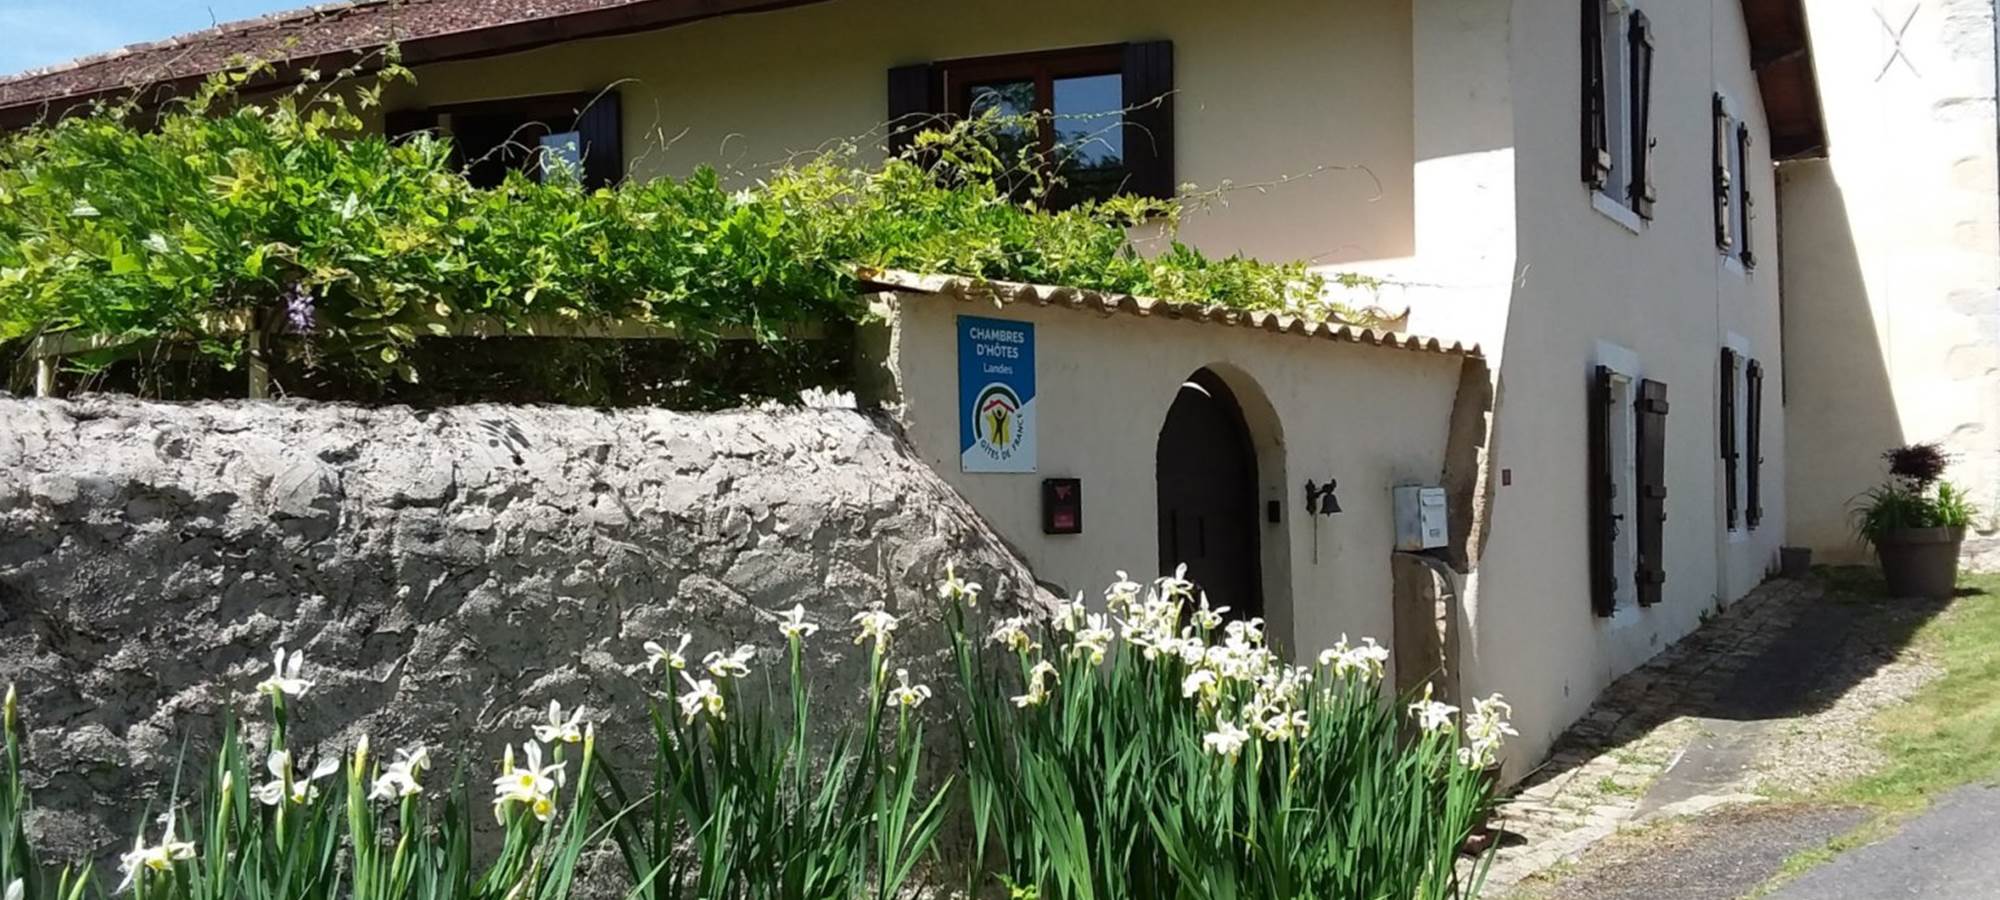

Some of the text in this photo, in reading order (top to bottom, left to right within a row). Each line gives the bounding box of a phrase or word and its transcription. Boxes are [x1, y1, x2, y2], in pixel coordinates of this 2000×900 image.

[969, 327, 1025, 343] CHAMBRES
[976, 342, 1019, 359] D'HÔTES
[983, 362, 1014, 375] Landes
[1001, 448, 1012, 460] DE
[1011, 413, 1024, 451] FRANCE
